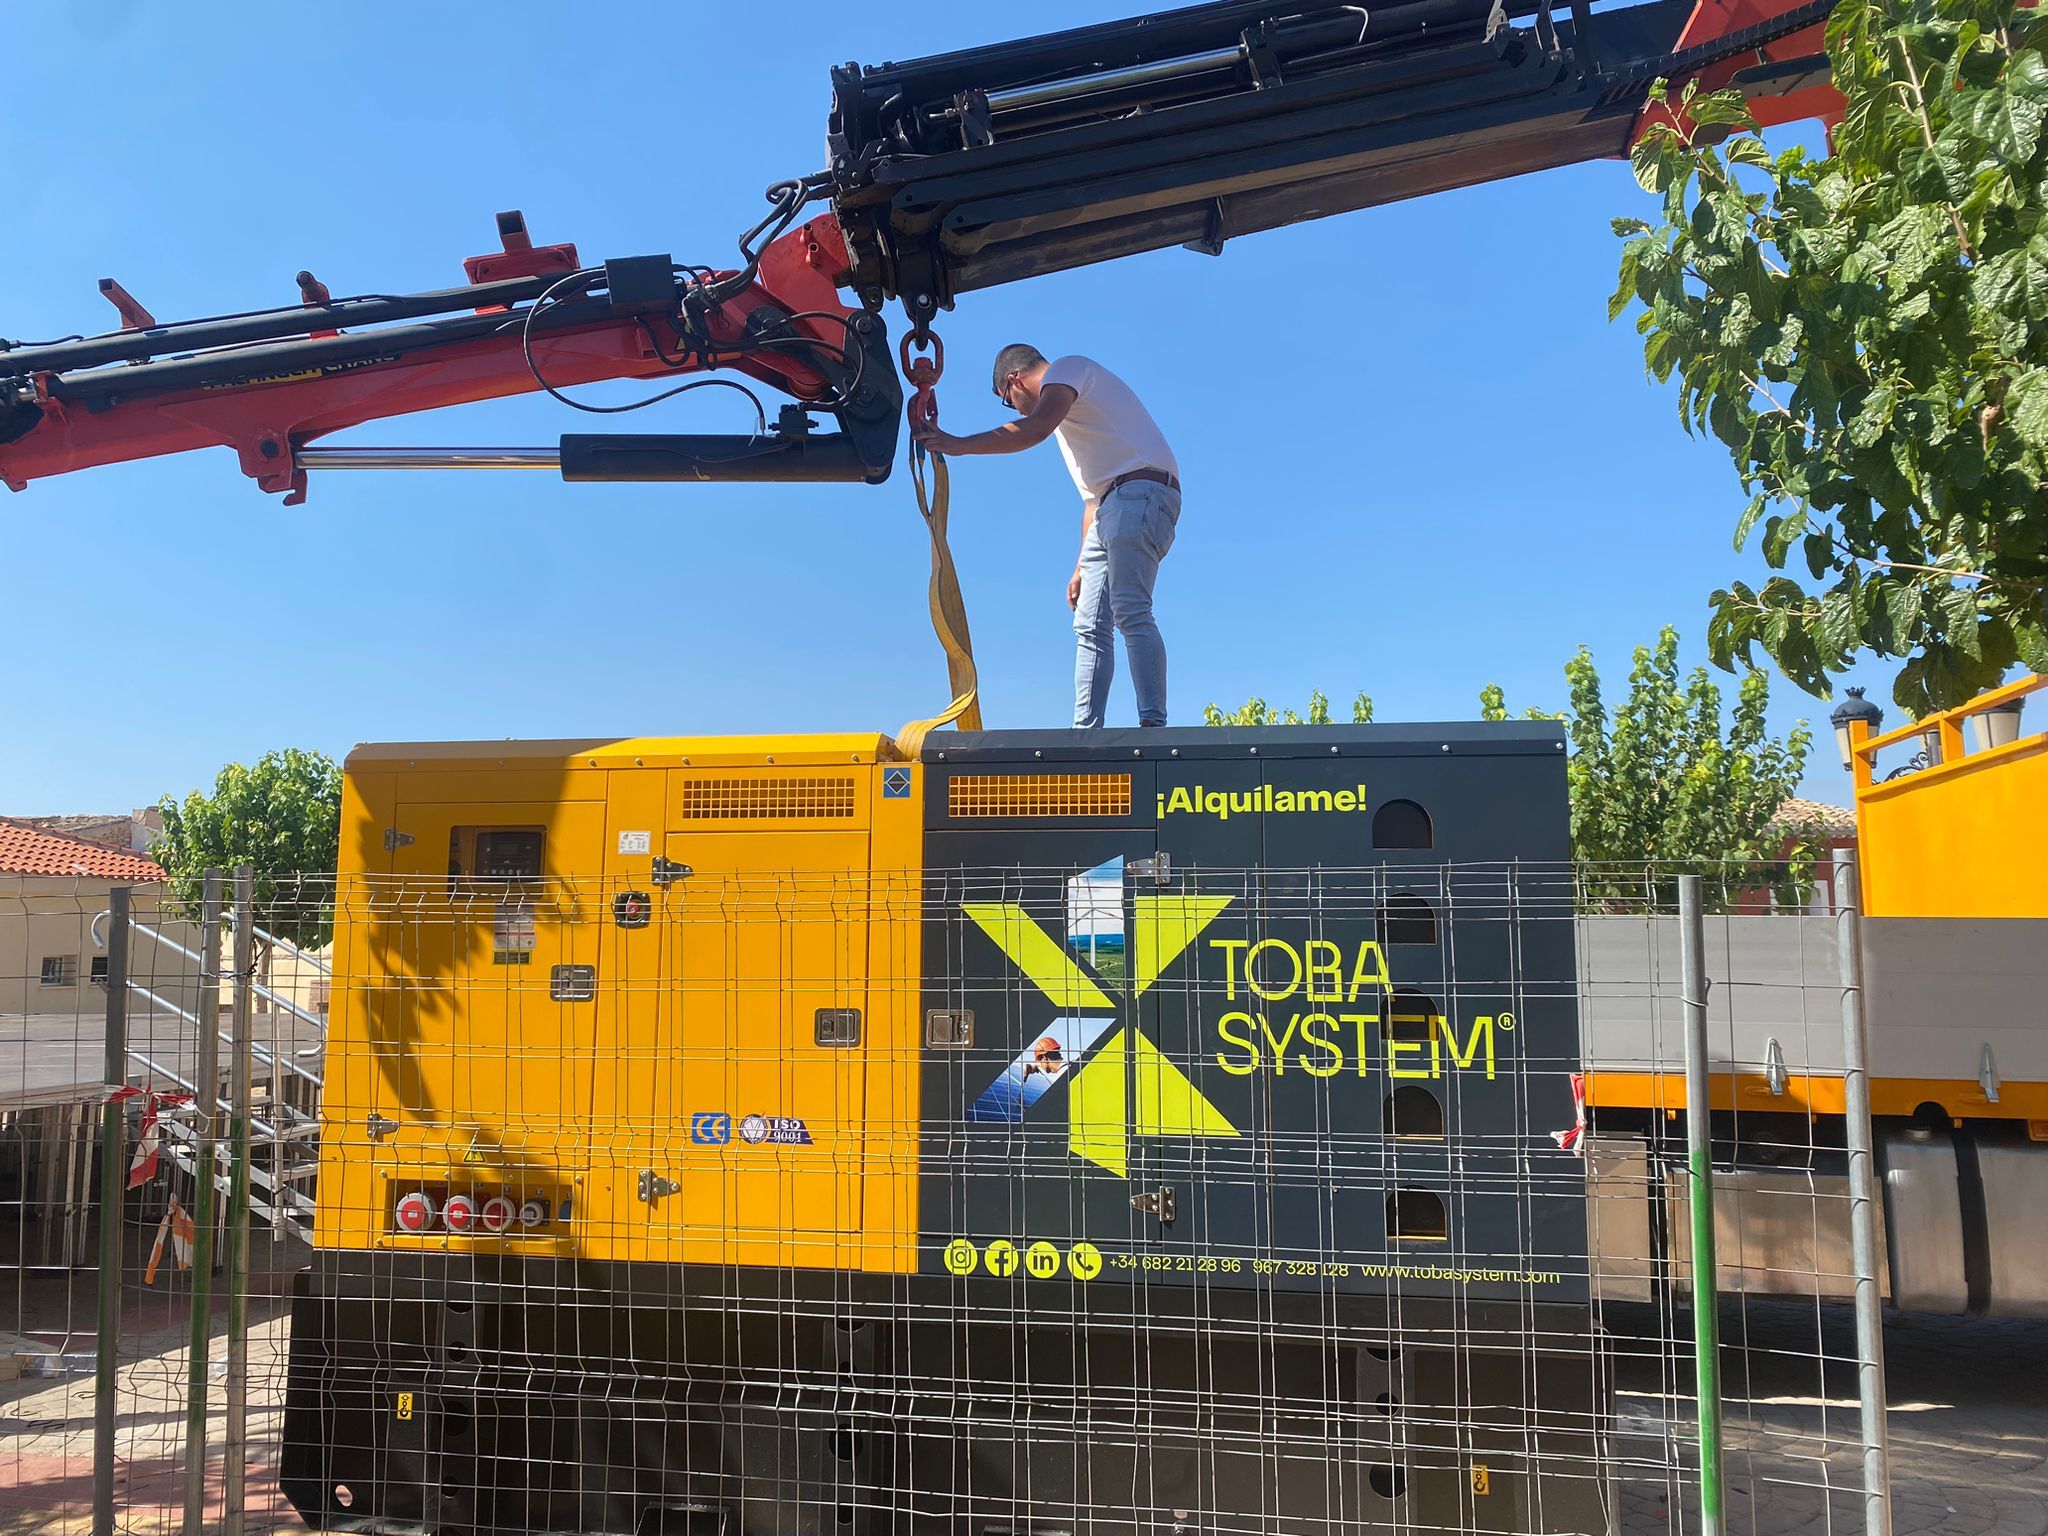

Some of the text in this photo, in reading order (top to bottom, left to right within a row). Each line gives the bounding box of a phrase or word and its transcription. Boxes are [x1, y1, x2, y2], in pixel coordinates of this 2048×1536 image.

[1156, 784, 1366, 820] ¡Alquílame!
[1209, 938, 1396, 1003] TOBA
[697, 1116, 725, 1141] CE
[773, 1120, 801, 1130] ISO
[773, 1131, 802, 1143] 9001
[1109, 1255, 1561, 1284] +34 682 21 28 96 967 328 128 www.tobasystem.com
